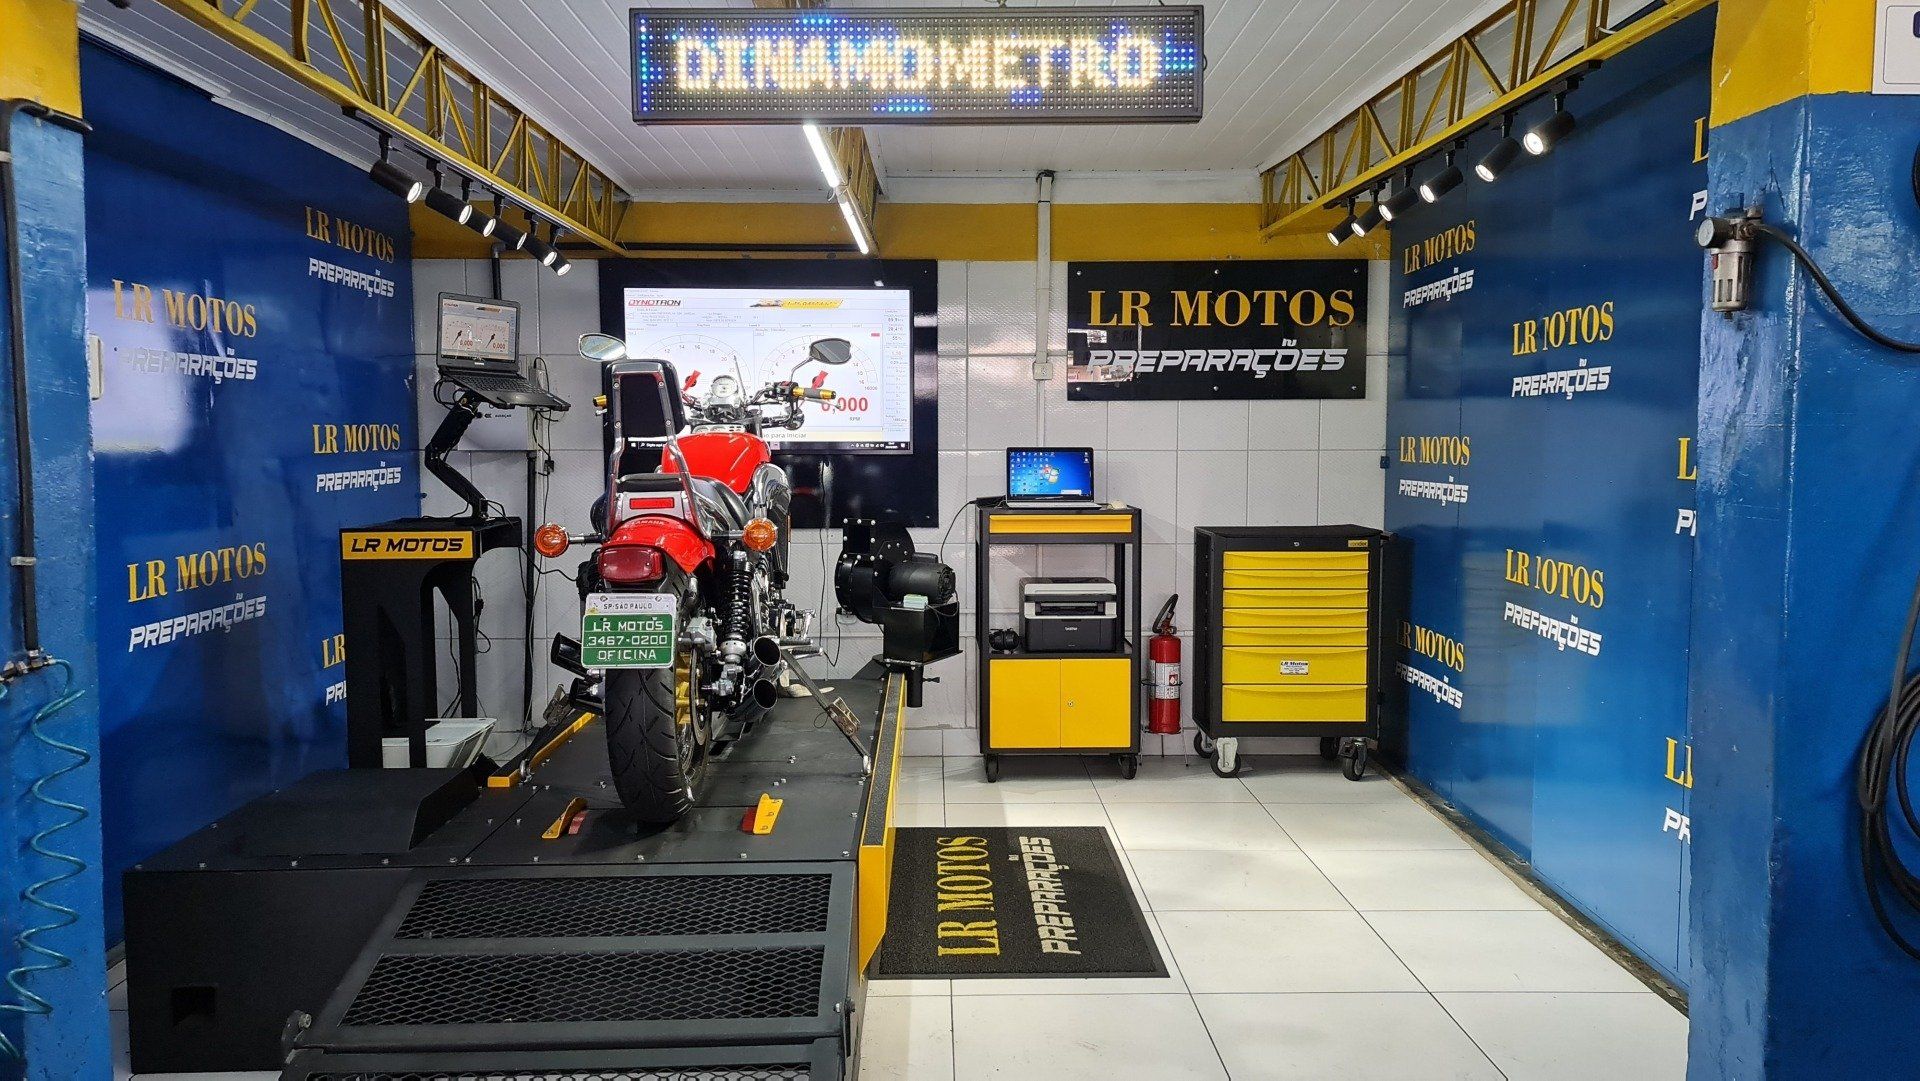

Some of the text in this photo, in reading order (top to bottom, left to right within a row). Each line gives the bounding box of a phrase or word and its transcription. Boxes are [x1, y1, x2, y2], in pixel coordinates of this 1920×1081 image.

[674, 36, 1162, 90] DINAMOMETRO
[305, 206, 394, 263] LR MOTOS
[1403, 220, 1475, 275] LR MOTOS
[309, 257, 395, 297] PREPARAÇÕES
[1403, 267, 1474, 308] PREPARAÇÕES
[112, 278, 257, 338] LR MOTOS
[628, 299, 681, 307] DYNOTRON
[1088, 289, 1355, 327] LR MOTOS
[1512, 320, 1537, 355] LR
[1087, 338, 1348, 379] PREPARAÇÕES
[313, 423, 400, 454] LR MOTOS
[1400, 436, 1470, 466] LR MOTOS
[316, 461, 402, 493] PREPARAÇÕES
[1399, 475, 1469, 507] PREPARAÇÕES
[351, 537, 464, 552] LR MOTOS
[127, 542, 267, 603] LR MOTOS
[1505, 548, 1530, 586] LR
[128, 593, 267, 652] PREPARAÇÕES
[588, 635, 668, 646] 3467-0200
[593, 620, 664, 631] LR MOTOS
[598, 650, 657, 661] OFICINA
[1414, 624, 1464, 672] MOTOS
[1395, 660, 1464, 709] PREPARAÇÕES
[937, 836, 1000, 956] LR MOTOS
[1008, 836, 1082, 955] PREPARAÇÕES
